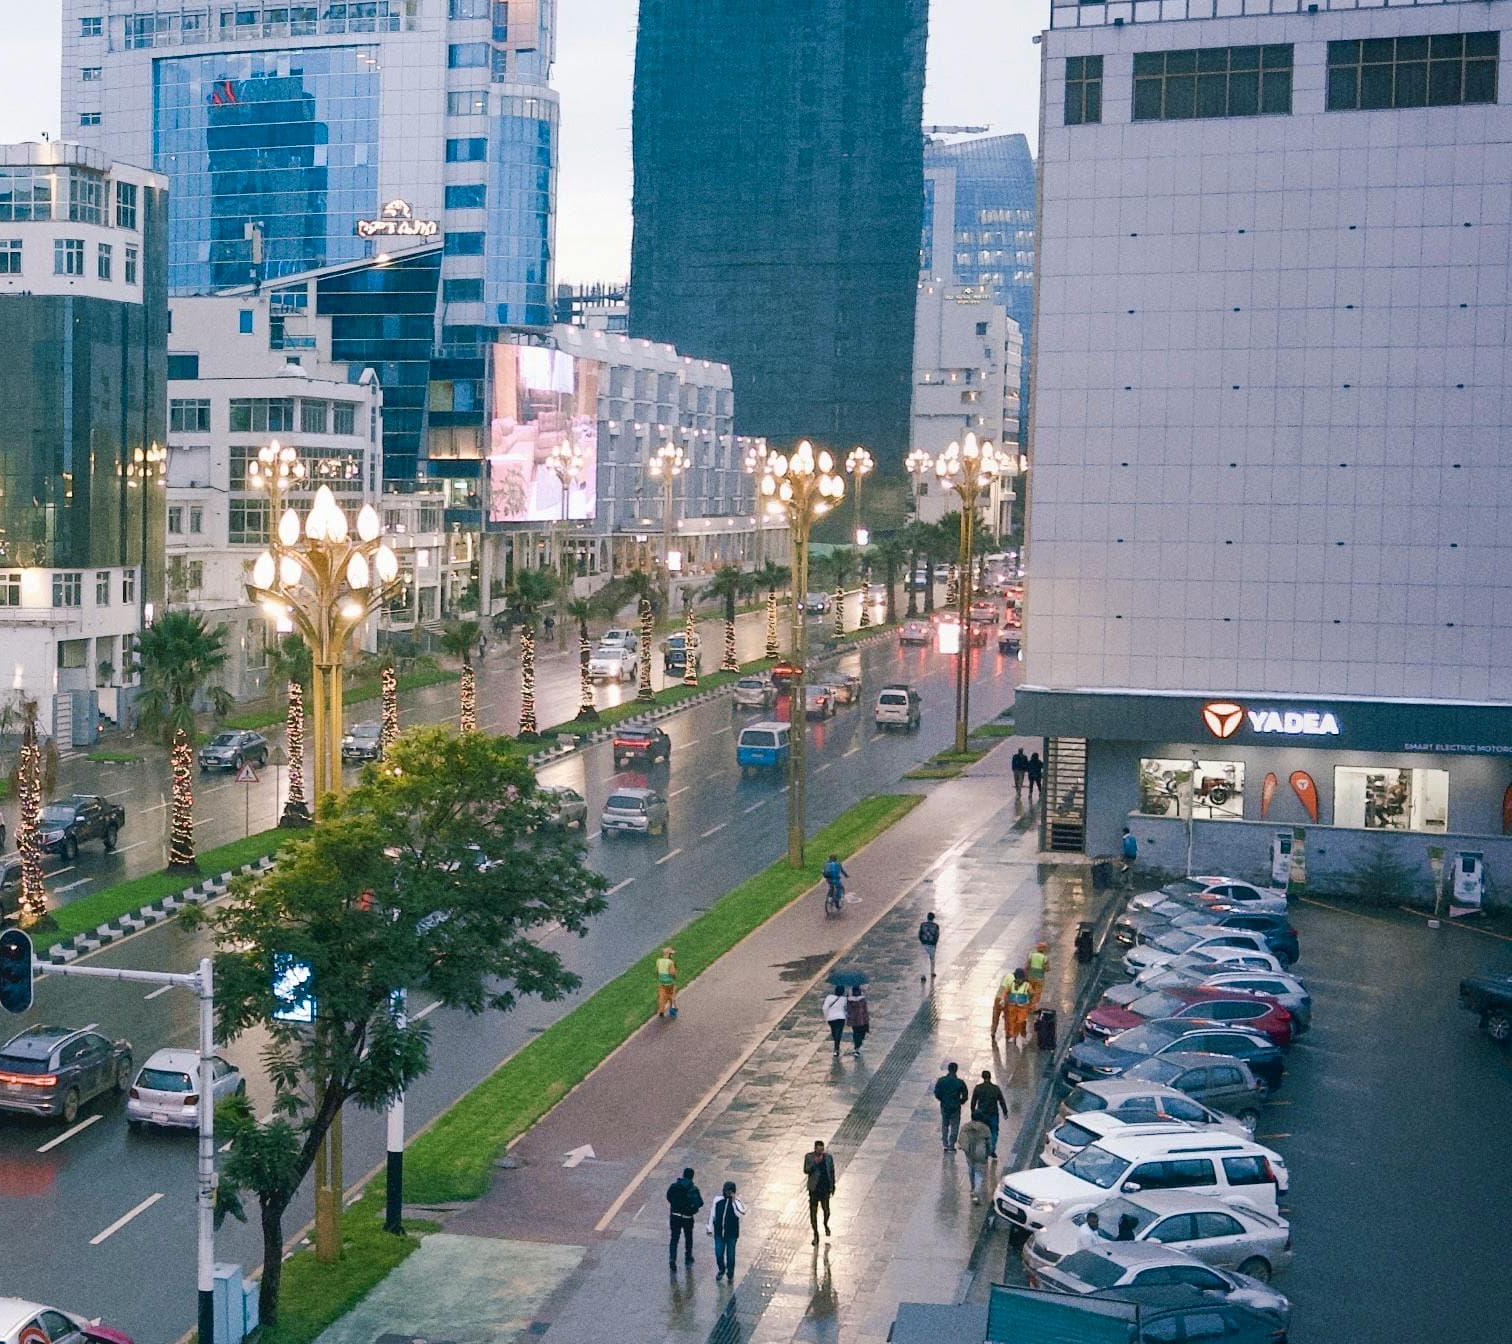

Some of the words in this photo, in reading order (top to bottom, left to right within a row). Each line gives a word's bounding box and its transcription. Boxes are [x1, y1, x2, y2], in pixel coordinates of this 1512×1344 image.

[1248, 710, 1339, 735] YADEA
[1404, 743, 1433, 751] SMART
[1435, 743, 1475, 752] ELECTRIC
